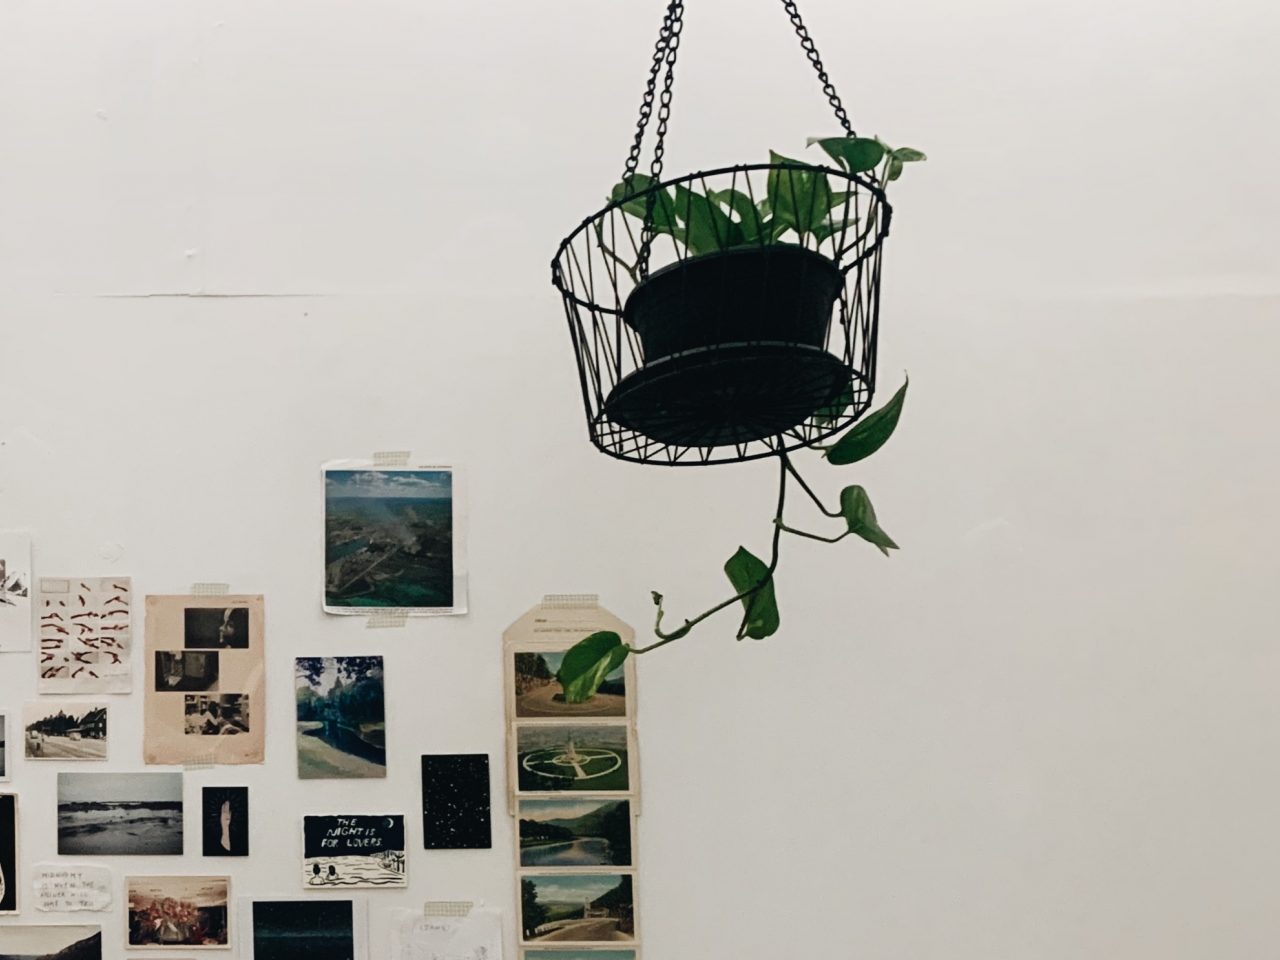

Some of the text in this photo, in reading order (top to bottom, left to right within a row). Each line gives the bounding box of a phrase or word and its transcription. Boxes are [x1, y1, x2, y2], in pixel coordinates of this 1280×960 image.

[337, 818, 357, 826] THE
[326, 827, 364, 837] NIGHT
[321, 839, 339, 848] FOR
